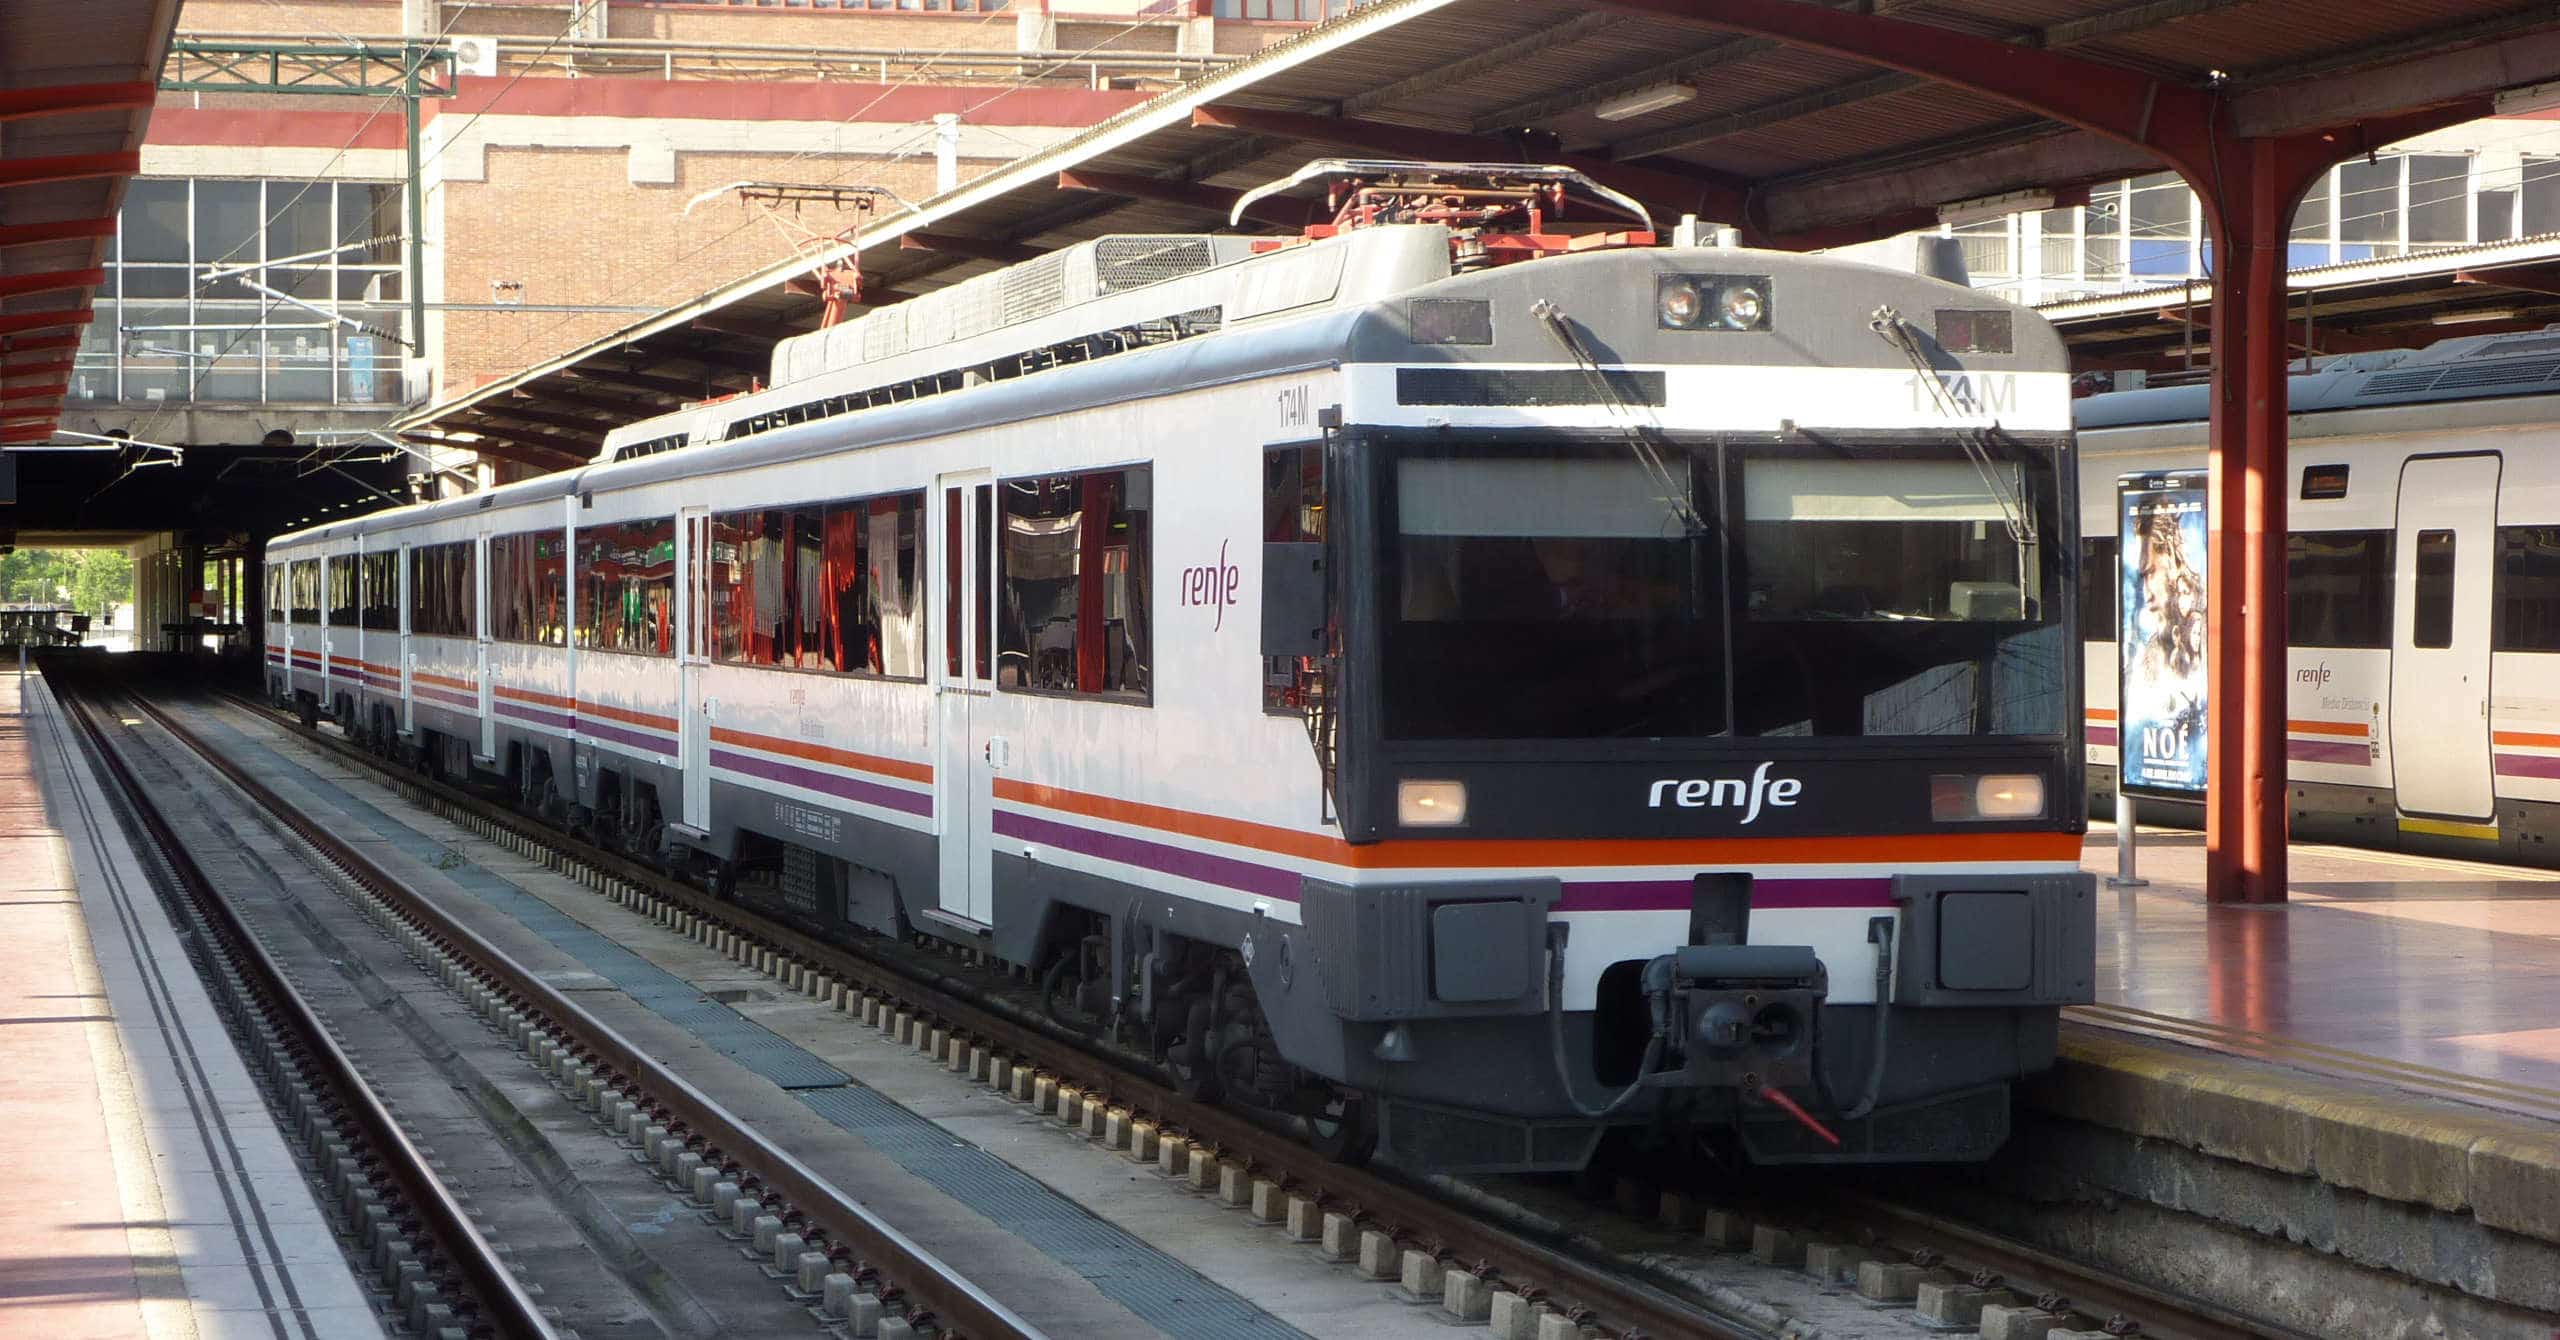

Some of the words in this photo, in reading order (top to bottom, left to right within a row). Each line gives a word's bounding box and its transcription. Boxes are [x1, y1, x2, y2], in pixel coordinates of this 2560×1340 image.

[1278, 385, 1309, 428] 174M
[1904, 374, 2017, 413] 174M
[1181, 537, 1239, 633] renfe
[2296, 660, 2331, 690] renfe
[2143, 722, 2190, 760] NOÉ
[1648, 761, 1802, 825] renfe
